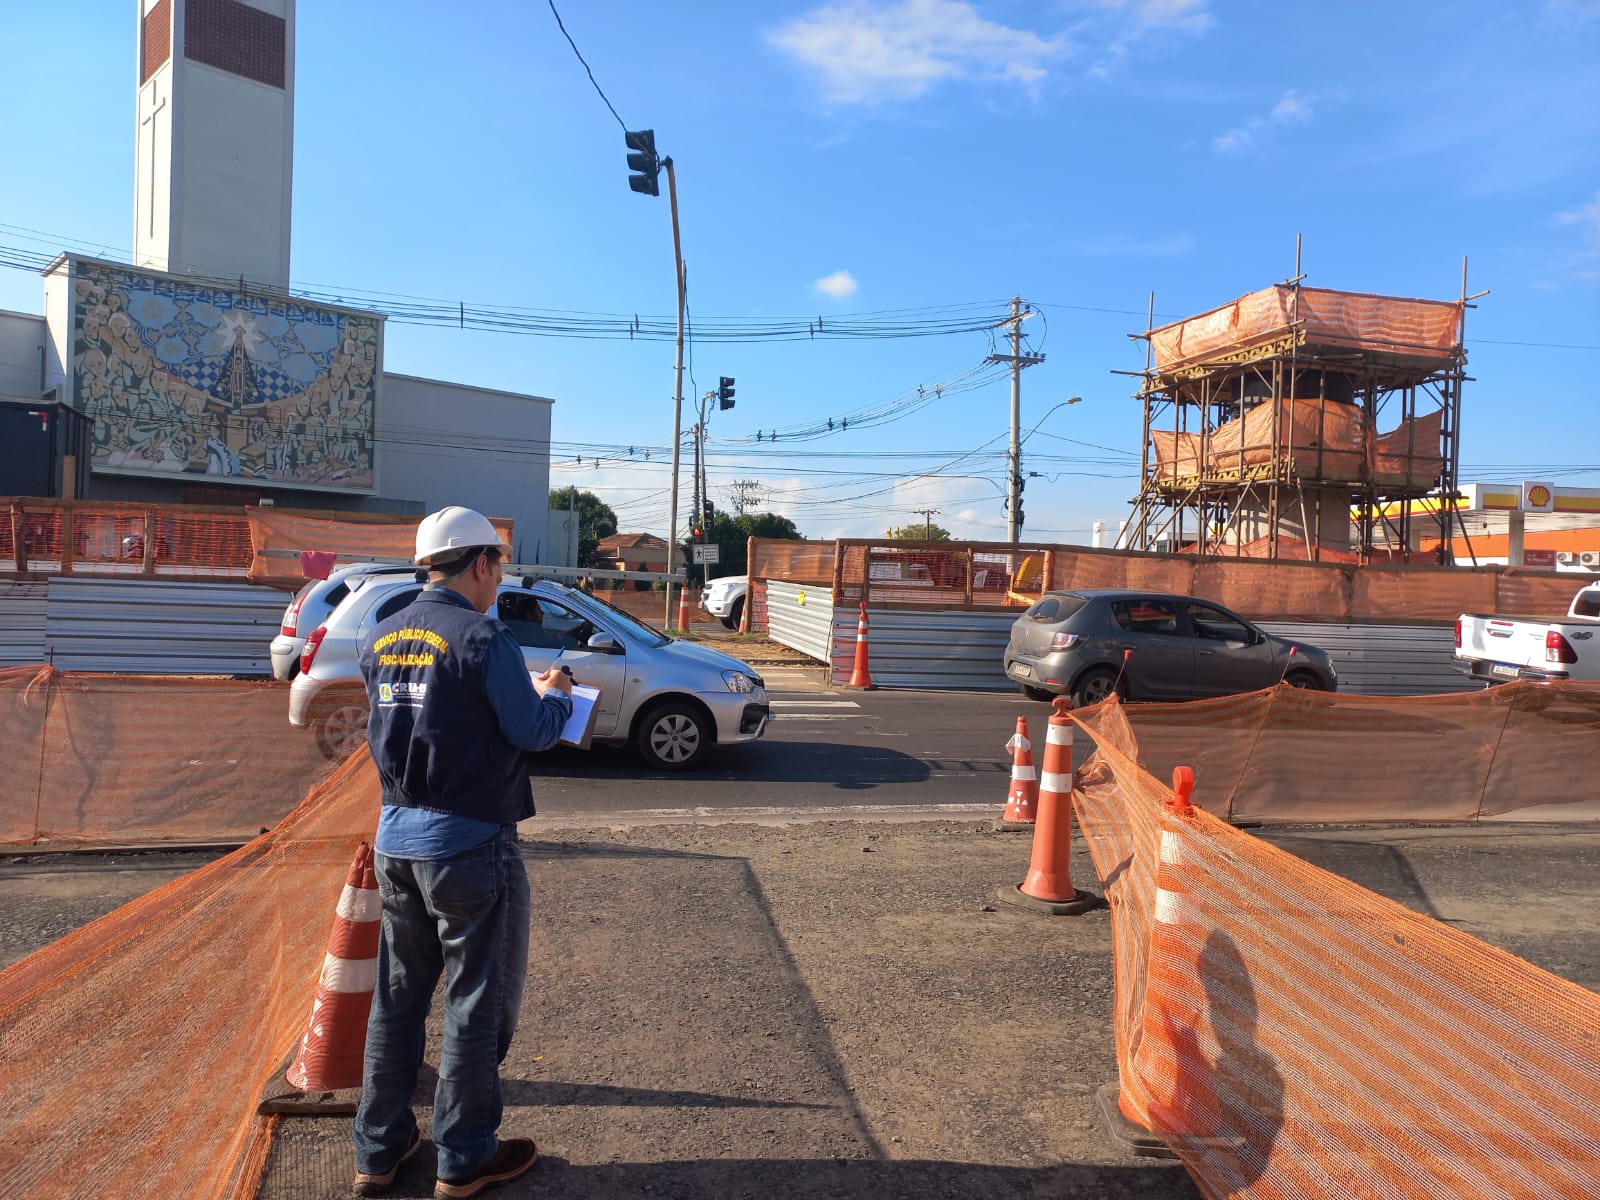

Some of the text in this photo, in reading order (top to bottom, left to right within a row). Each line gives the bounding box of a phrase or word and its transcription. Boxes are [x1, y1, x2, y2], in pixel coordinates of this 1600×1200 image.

[373, 627, 449, 653] SERVIÇO PÚBLICO FEDERAL
[379, 652, 434, 667] FISCALIZAÇÃO
